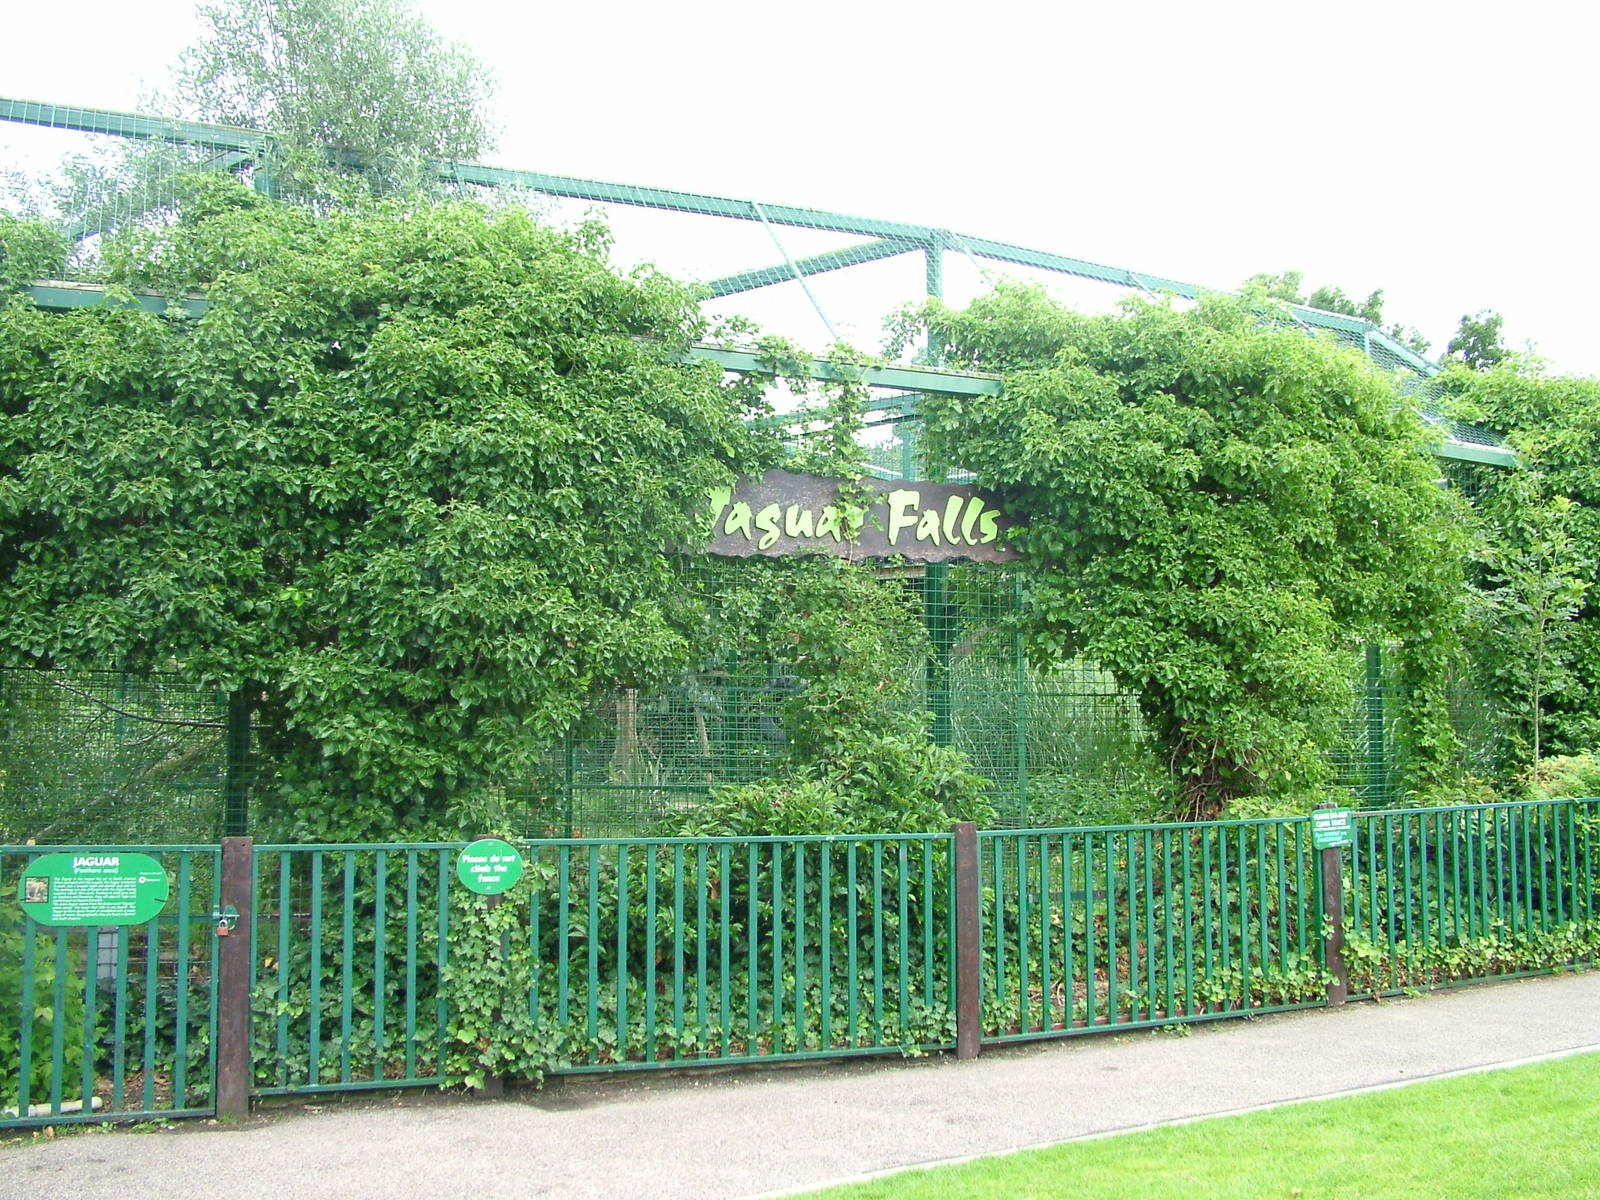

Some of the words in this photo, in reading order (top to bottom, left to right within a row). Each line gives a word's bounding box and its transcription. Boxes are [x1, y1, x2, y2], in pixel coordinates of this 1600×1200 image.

[888, 488, 1000, 546] Falls
[72, 856, 120, 868] JAGUAR
[462, 854, 487, 863] Please
[490, 854, 500, 863] do
[502, 854, 516, 863] not
[494, 864, 508, 872] the
[478, 873, 501, 883] fence
